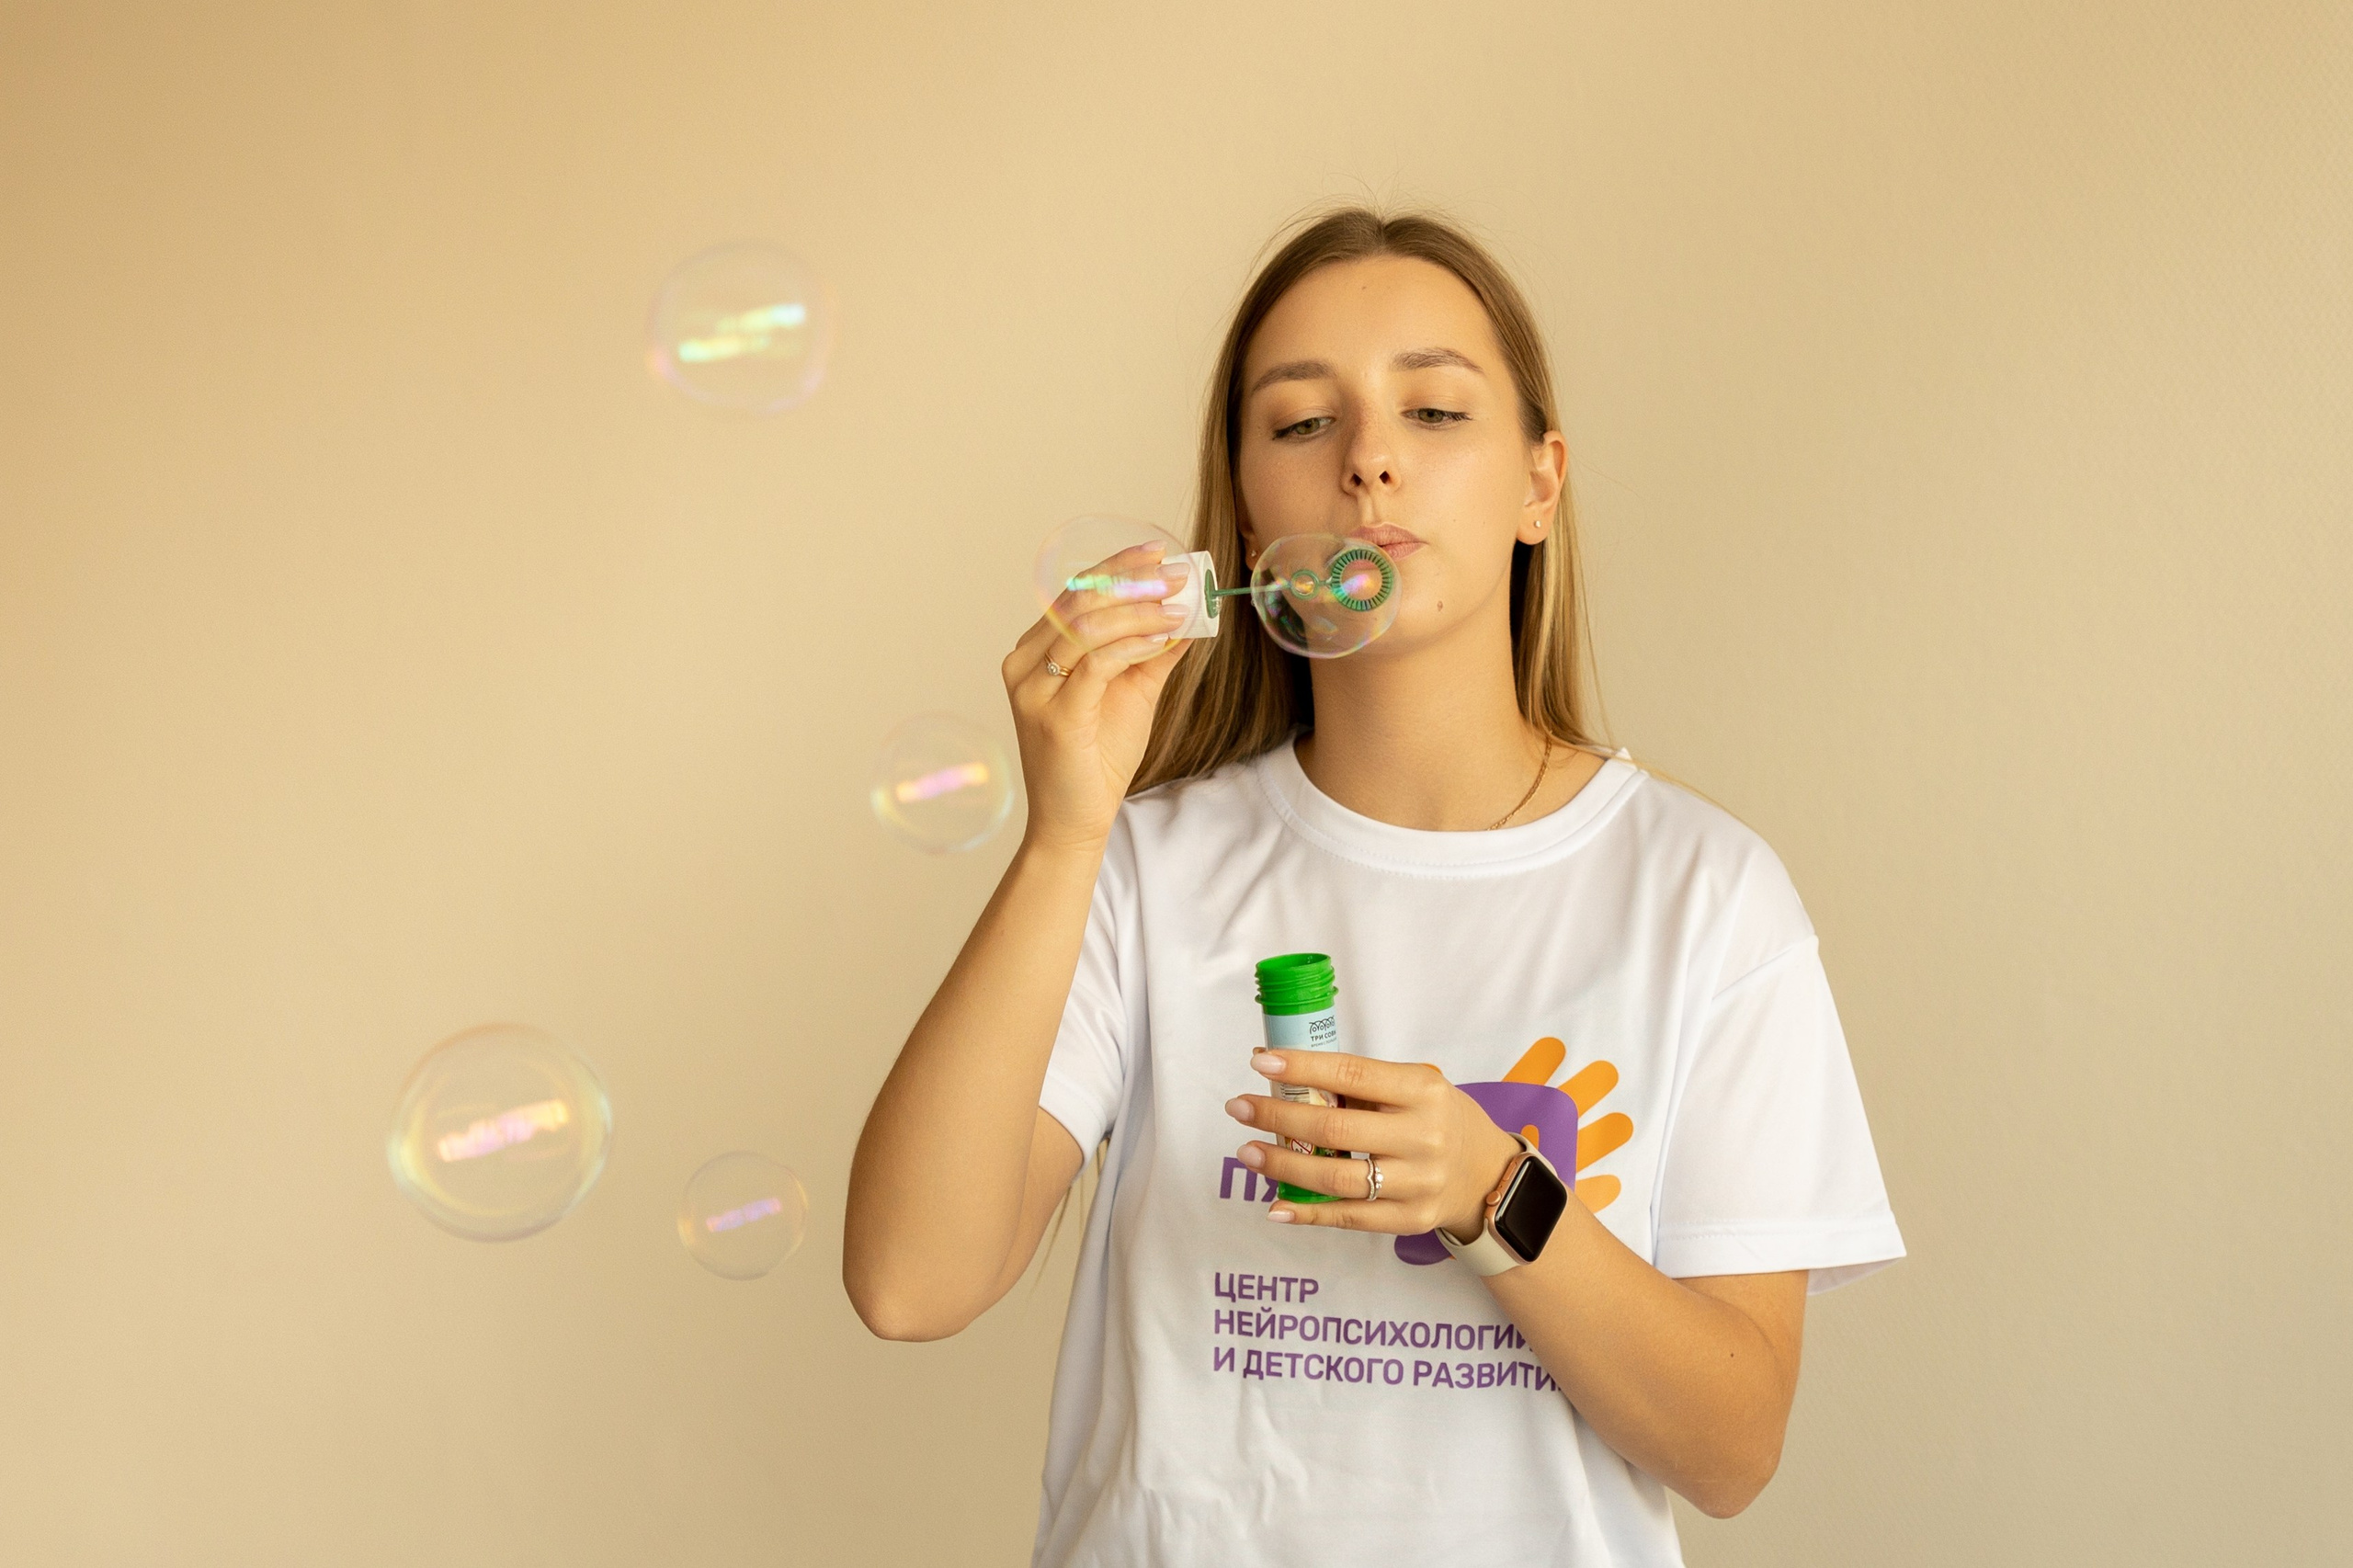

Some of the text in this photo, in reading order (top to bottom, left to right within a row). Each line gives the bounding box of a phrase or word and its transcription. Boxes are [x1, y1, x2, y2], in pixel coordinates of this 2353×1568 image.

[1214, 1272, 1319, 1302] ЦЕНТР
[1213, 1346, 1561, 1392] И ДЕТСКОГО РАЗВИТИ
